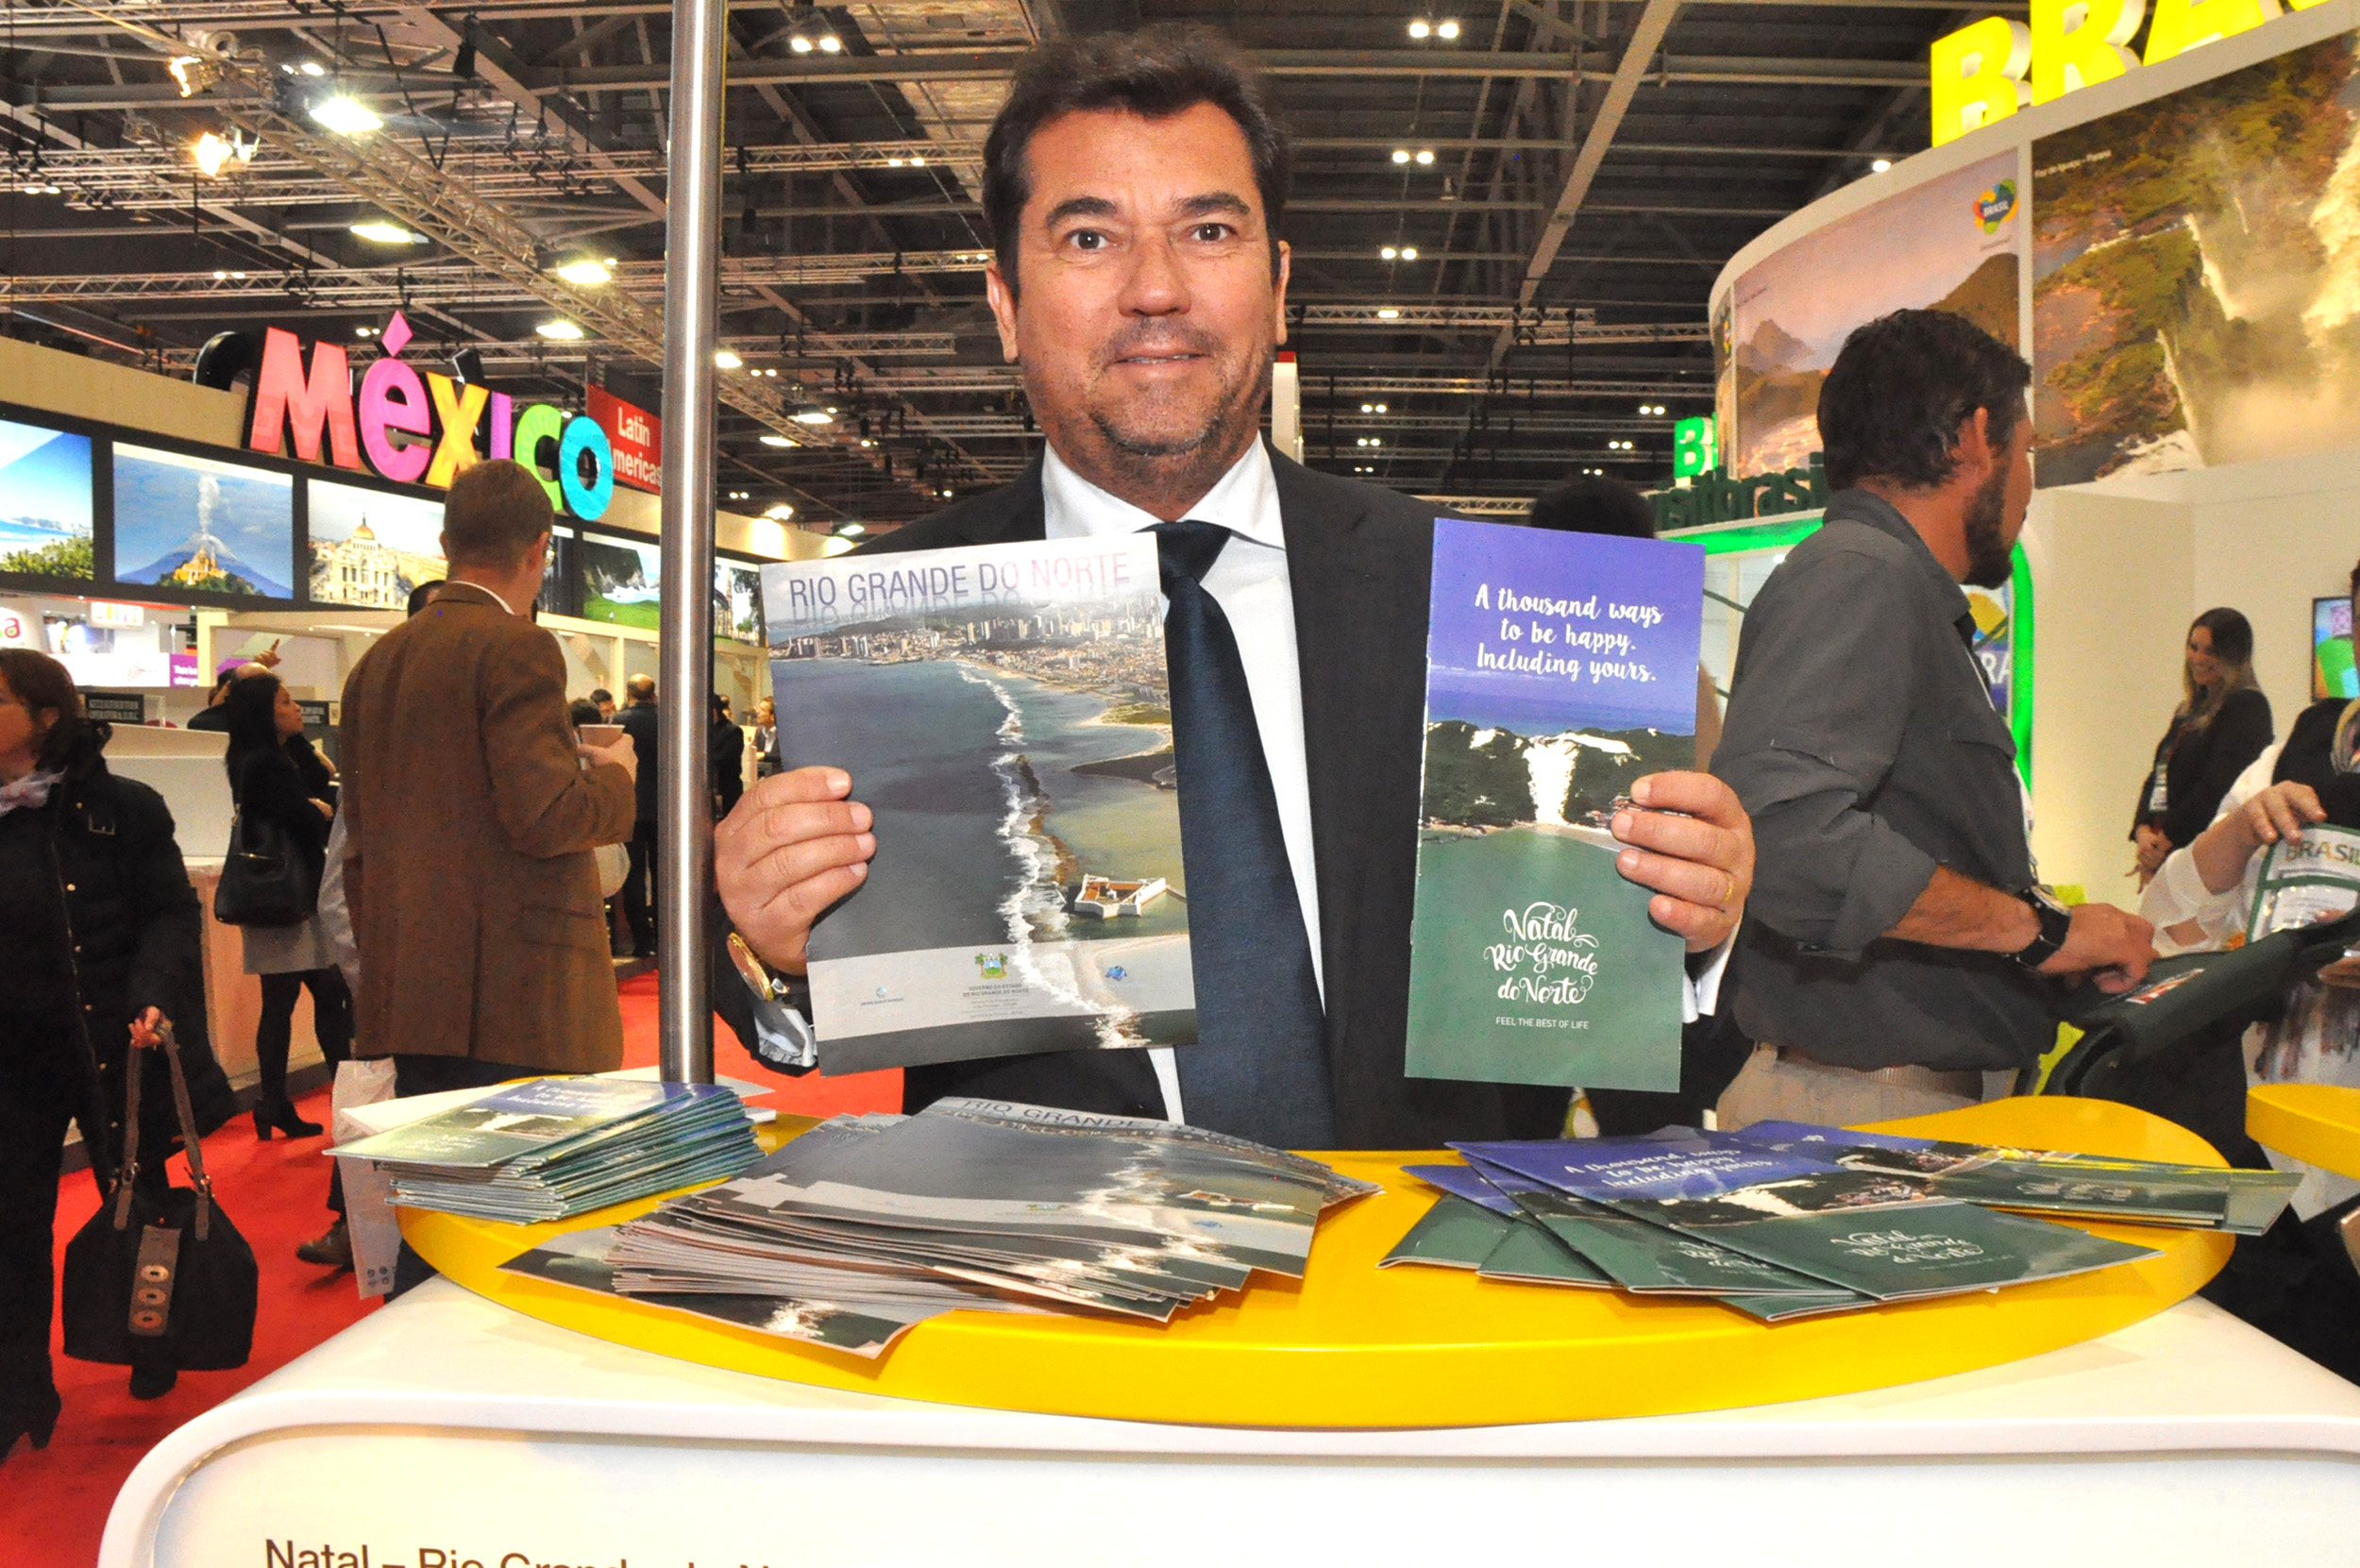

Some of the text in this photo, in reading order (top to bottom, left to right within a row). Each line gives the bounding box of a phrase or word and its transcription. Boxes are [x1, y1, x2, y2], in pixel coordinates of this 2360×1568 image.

[1931, 0, 2330, 147] BRA
[618, 406, 649, 447] Latin
[613, 447, 662, 486] mericas
[790, 551, 1130, 607] RIO GRANDE DO NORTE
[1475, 583, 1664, 629] A thousand ways
[1500, 618, 1636, 656] to be happy.
[1476, 642, 1657, 683] Including yours.
[1503, 902, 1599, 948] Natal
[1483, 943, 1598, 975] Rio Grande
[1497, 974, 1593, 1004] do Norte
[1495, 1016, 1590, 1031] FEEL THE BEST OF LIFE
